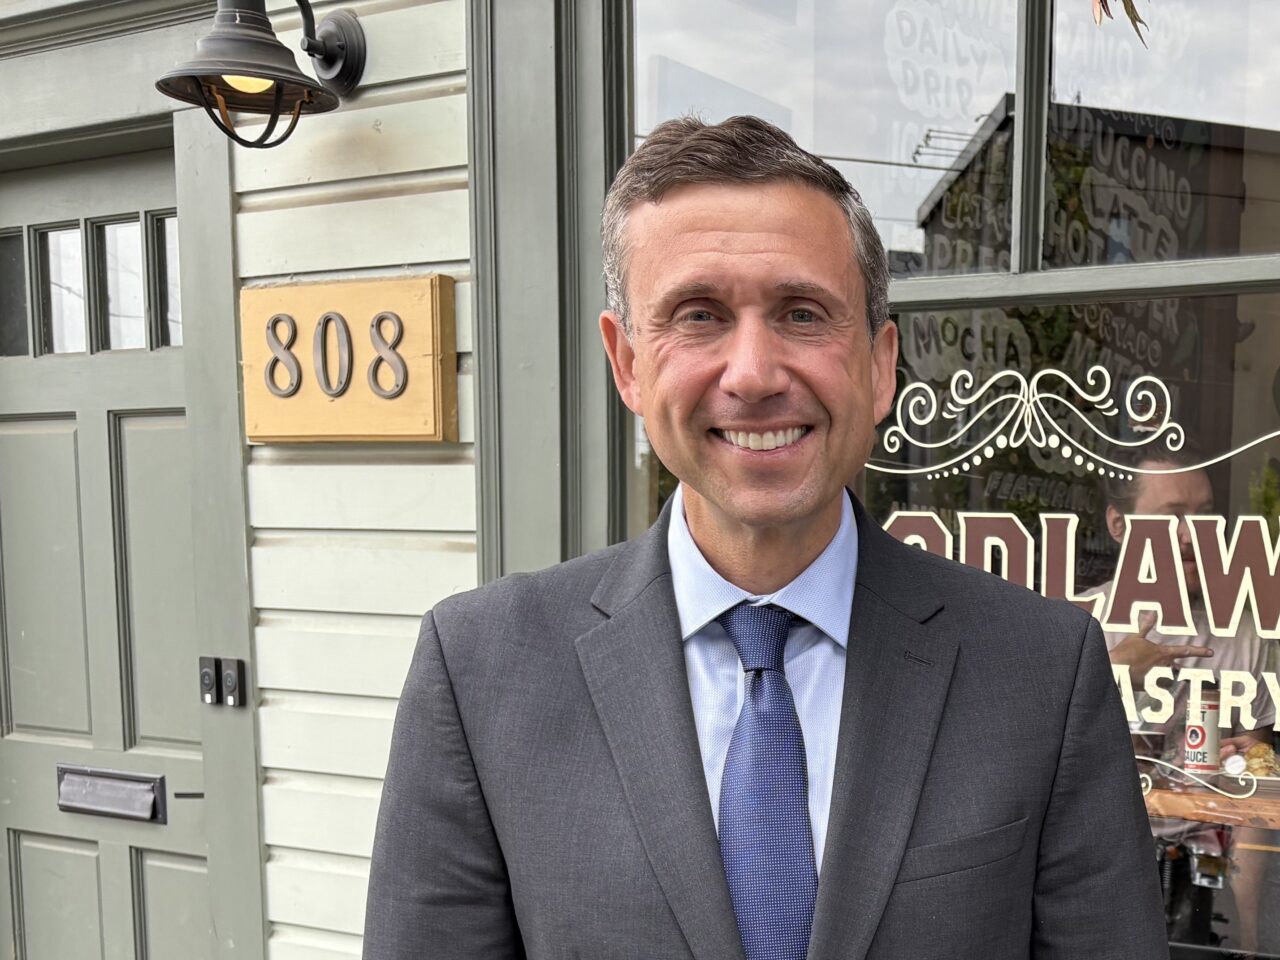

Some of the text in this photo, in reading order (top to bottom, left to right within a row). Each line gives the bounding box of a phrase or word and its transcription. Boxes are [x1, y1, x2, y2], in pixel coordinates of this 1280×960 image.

[895, 9, 989, 84] DAILY
[901, 59, 974, 118] DRIP
[264, 311, 408, 400] 808
[911, 313, 1022, 369] MOCHA
